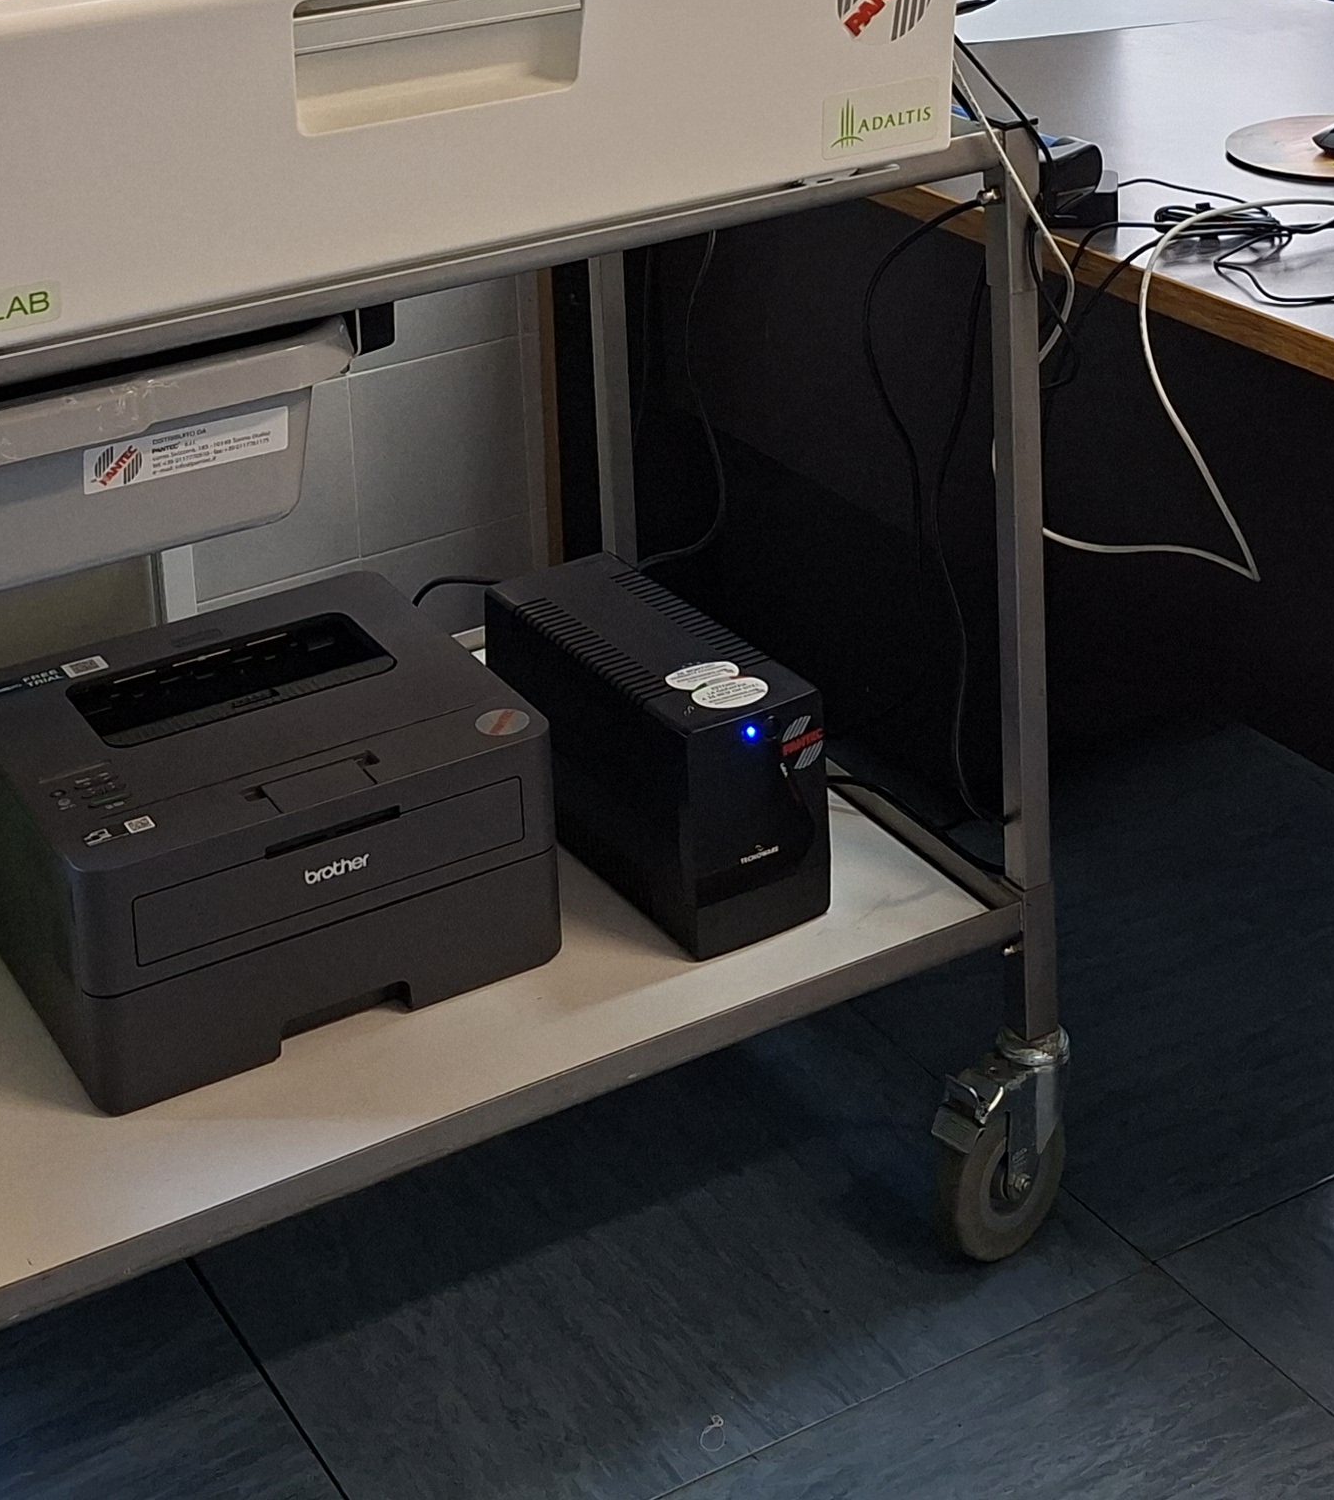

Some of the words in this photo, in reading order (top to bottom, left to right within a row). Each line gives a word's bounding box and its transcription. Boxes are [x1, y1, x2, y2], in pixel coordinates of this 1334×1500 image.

[858, 107, 931, 134] ADALTIS
[152, 430, 196, 444] DISTRIBUITO
[152, 442, 179, 453] PANTEC
[99, 444, 138, 486] PANTEC
[27, 674, 65, 686] TRIAL
[305, 853, 369, 884] brother
